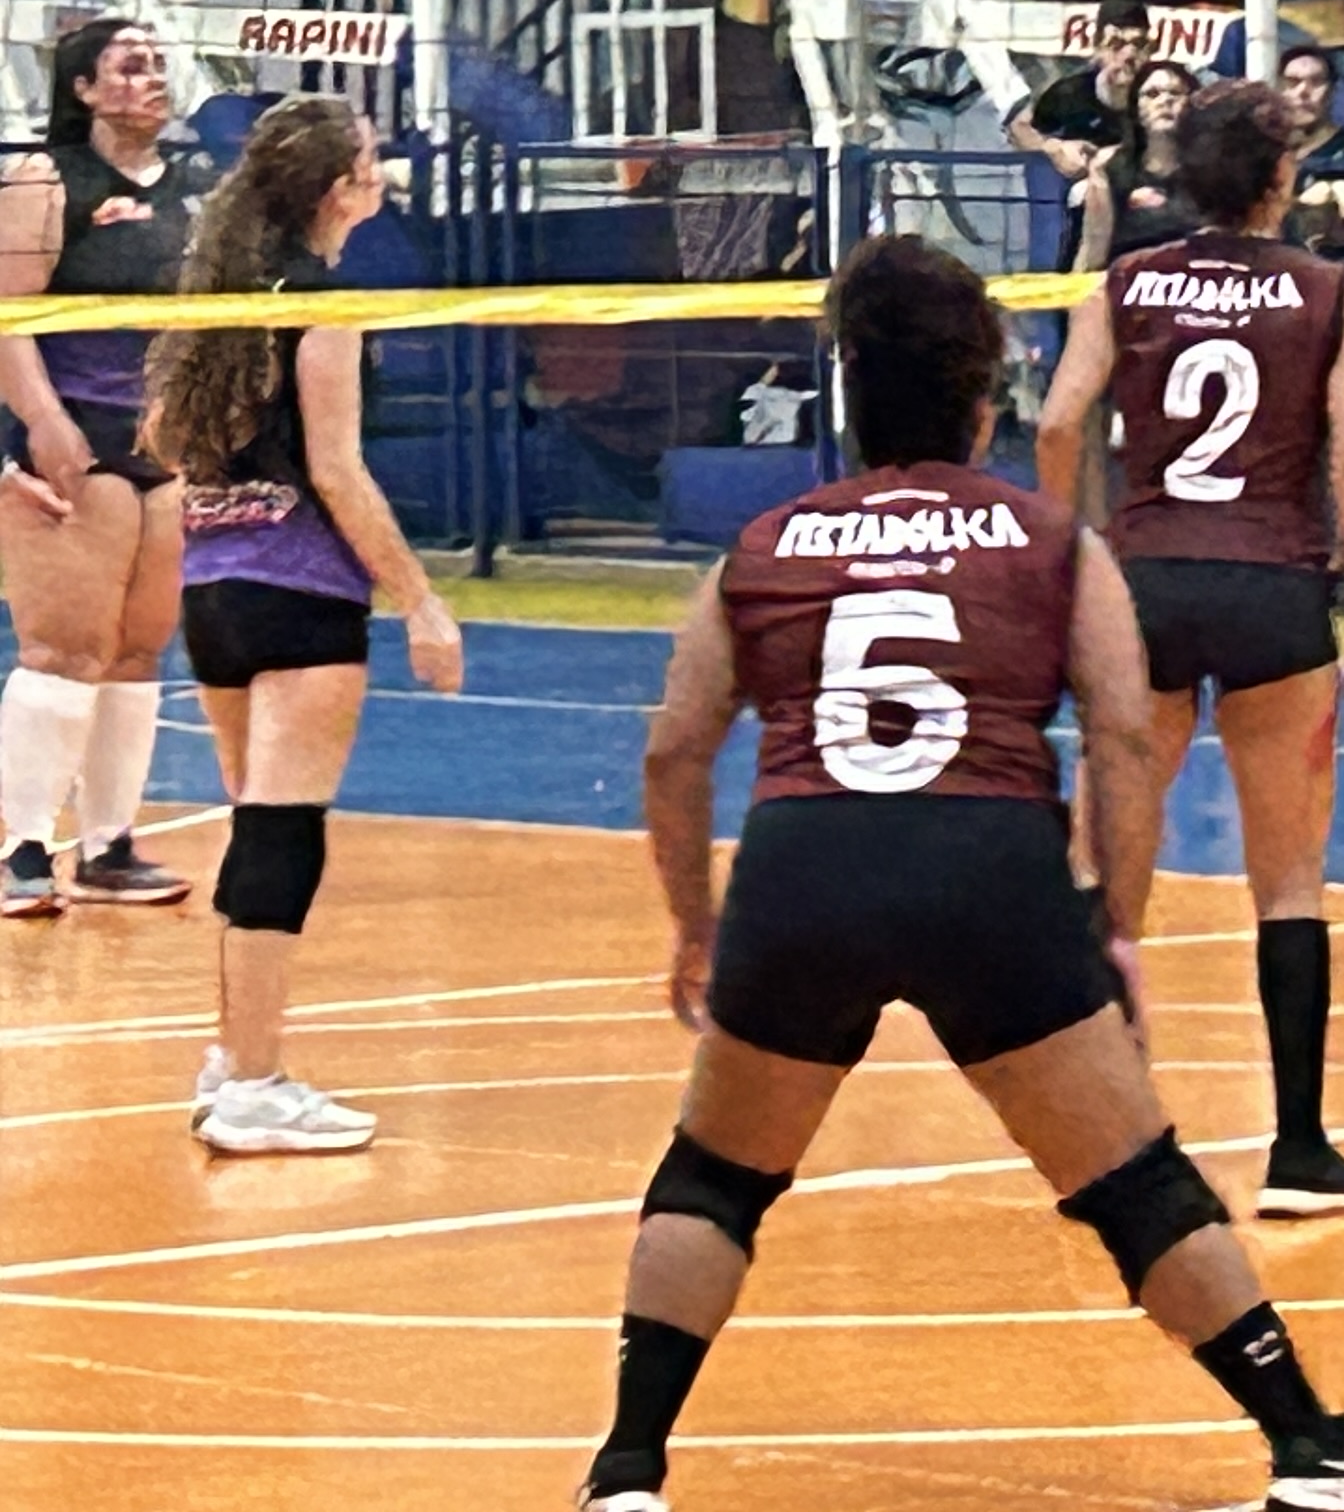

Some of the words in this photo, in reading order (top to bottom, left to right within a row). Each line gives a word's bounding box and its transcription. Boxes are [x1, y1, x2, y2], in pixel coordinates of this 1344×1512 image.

[238, 14, 388, 57] RAPINI
[1062, 13, 1214, 57] RINI
[1162, 338, 1260, 502] 2
